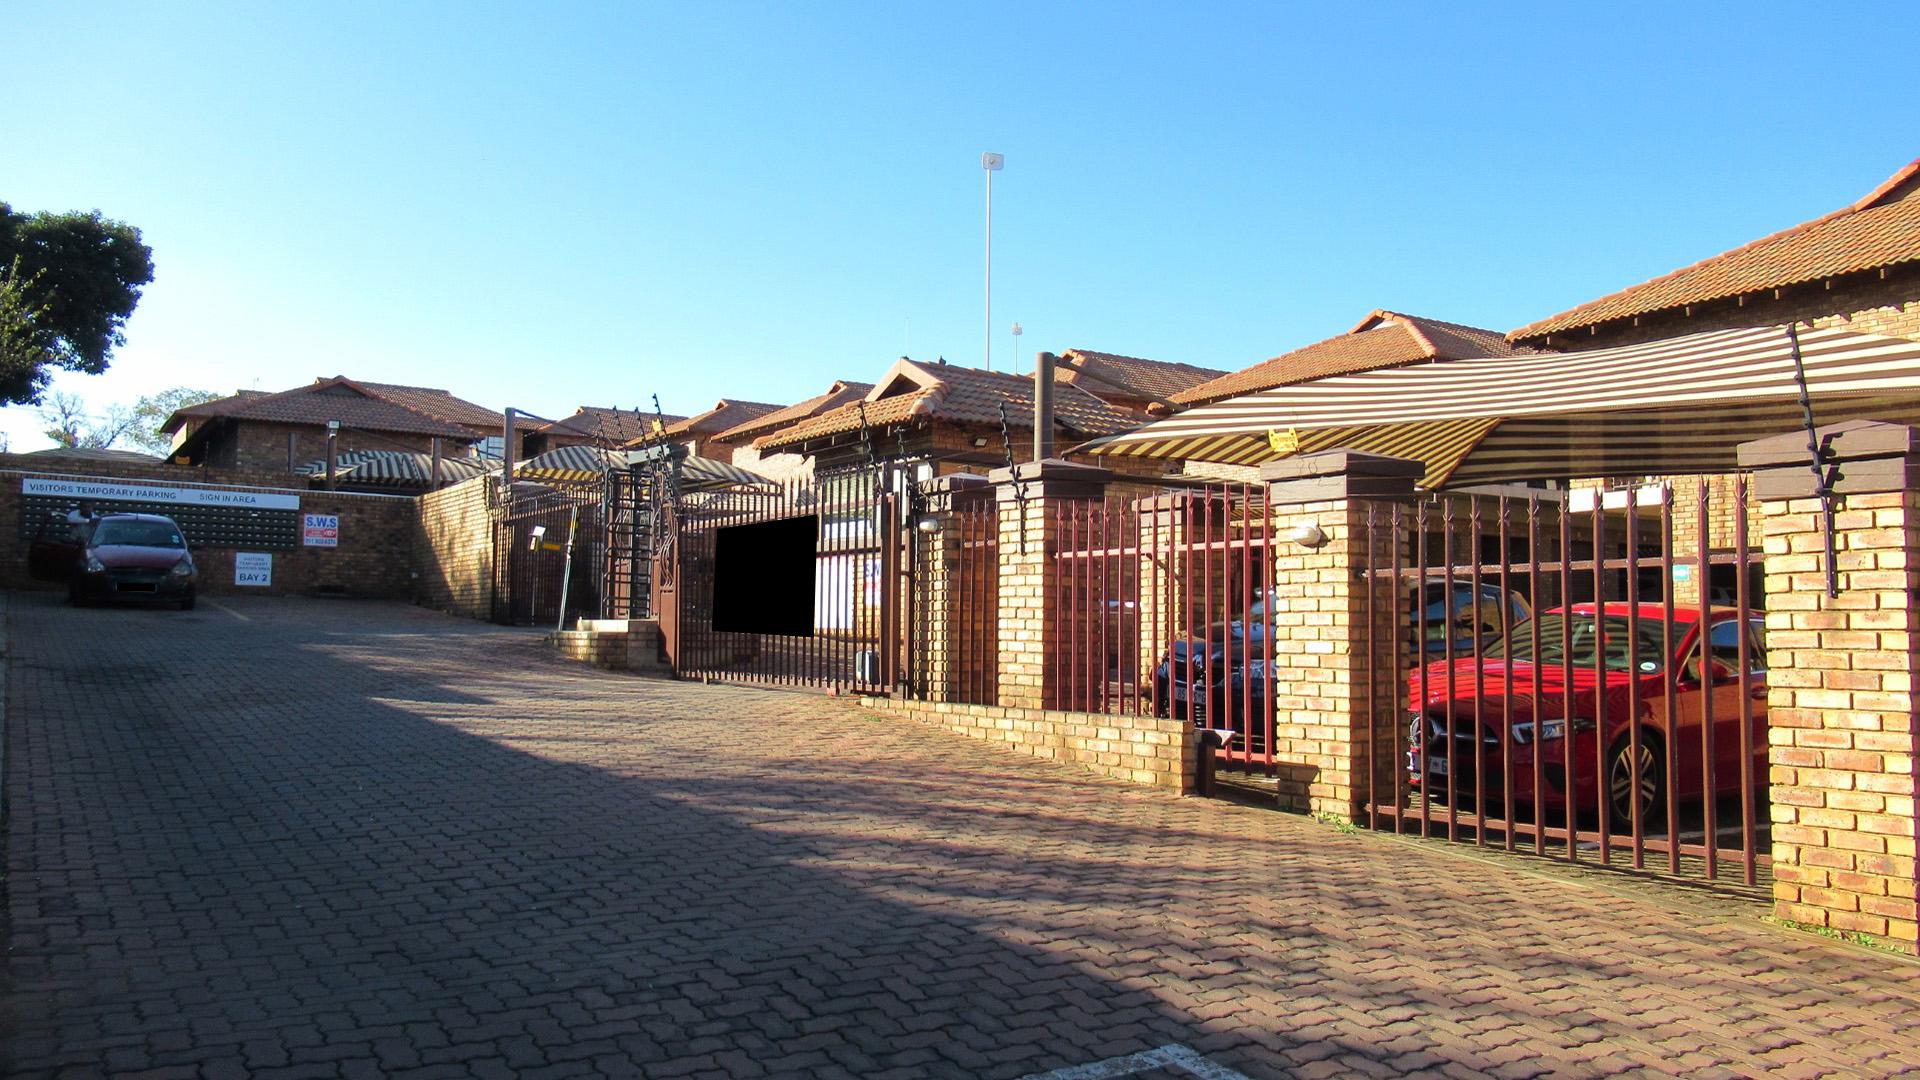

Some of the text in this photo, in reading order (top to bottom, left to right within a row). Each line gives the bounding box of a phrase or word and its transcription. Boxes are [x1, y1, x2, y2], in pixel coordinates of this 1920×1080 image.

[29, 483, 256, 503] VISITORS TEMPORARY PARKING SIGN IN AREA
[306, 516, 337, 528] S.W.S
[239, 572, 268, 582] BAY 2
